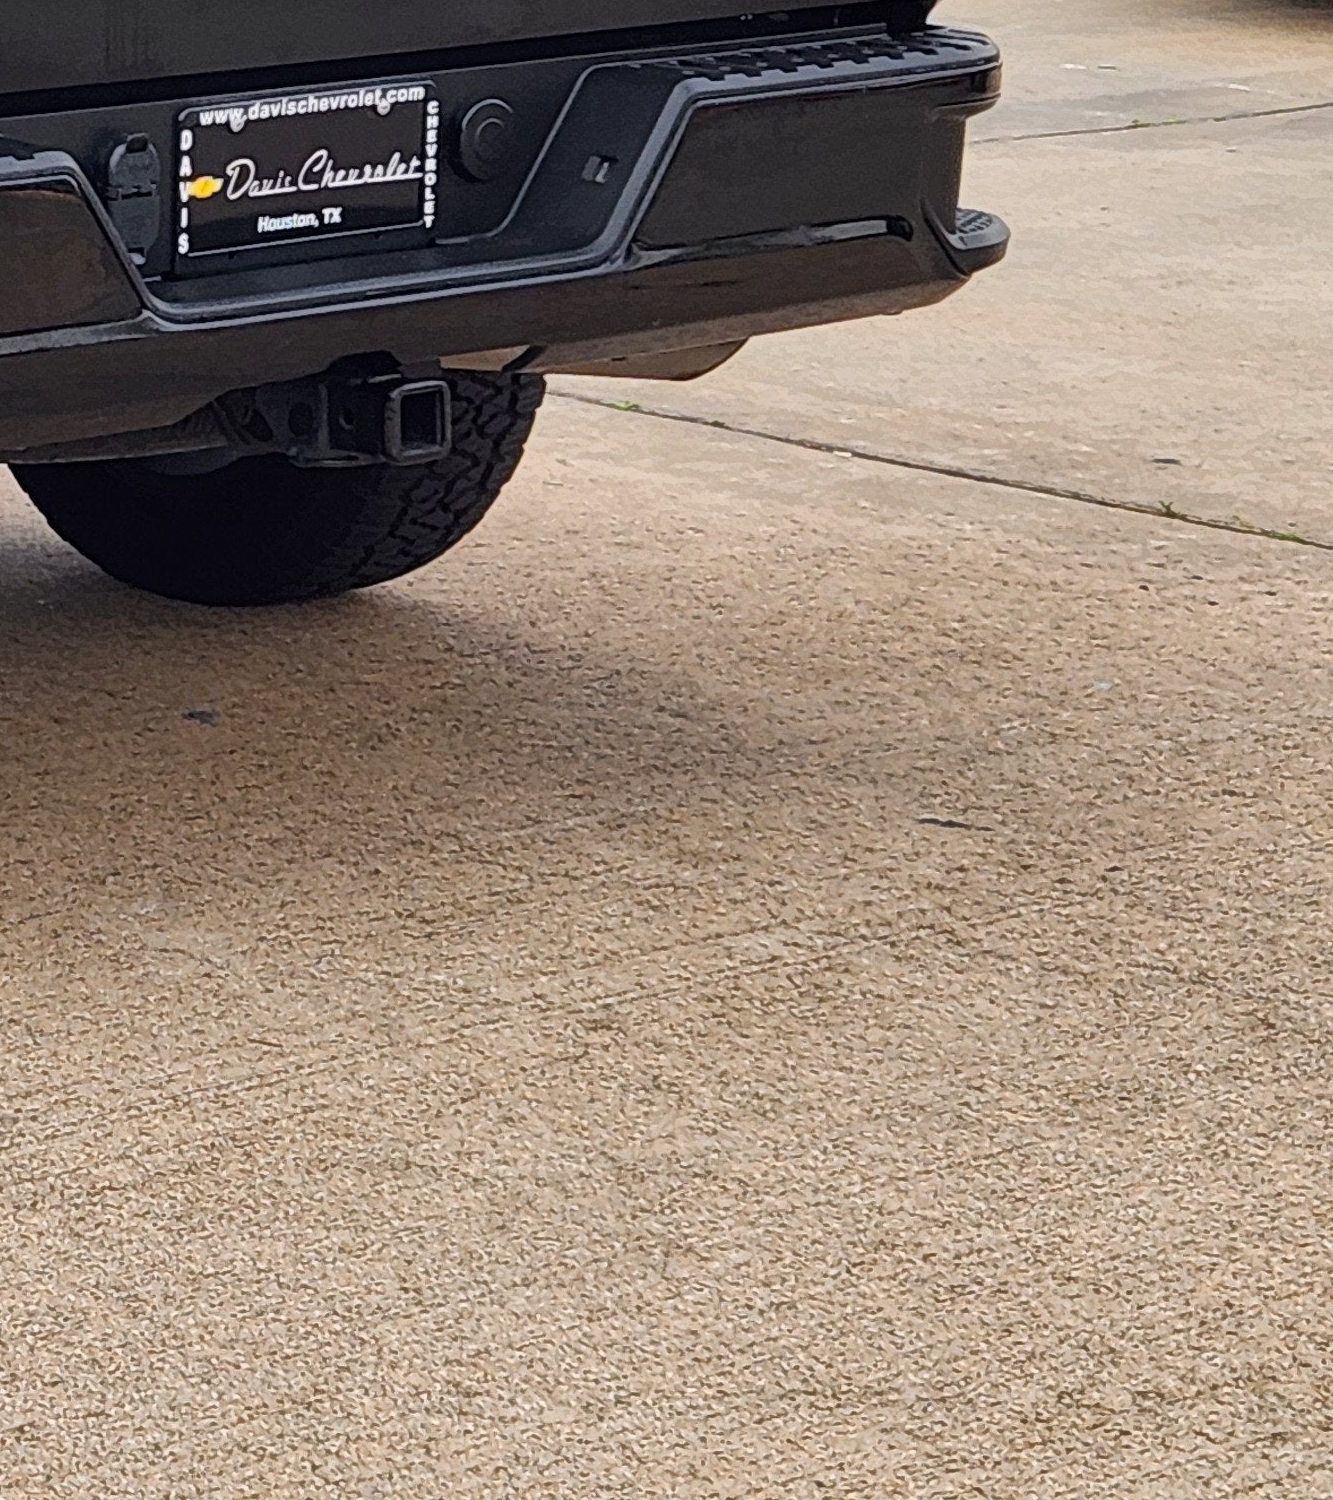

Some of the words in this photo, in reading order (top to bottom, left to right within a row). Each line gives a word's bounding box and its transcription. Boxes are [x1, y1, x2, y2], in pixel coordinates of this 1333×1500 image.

[199, 86, 426, 126] www.davischevrolet.com
[226, 157, 297, 201] Davis
[297, 148, 423, 191] Chevrolet
[423, 100, 440, 228] CHEVROLET
[177, 129, 193, 255] DAVIS
[322, 206, 342, 224] TX
